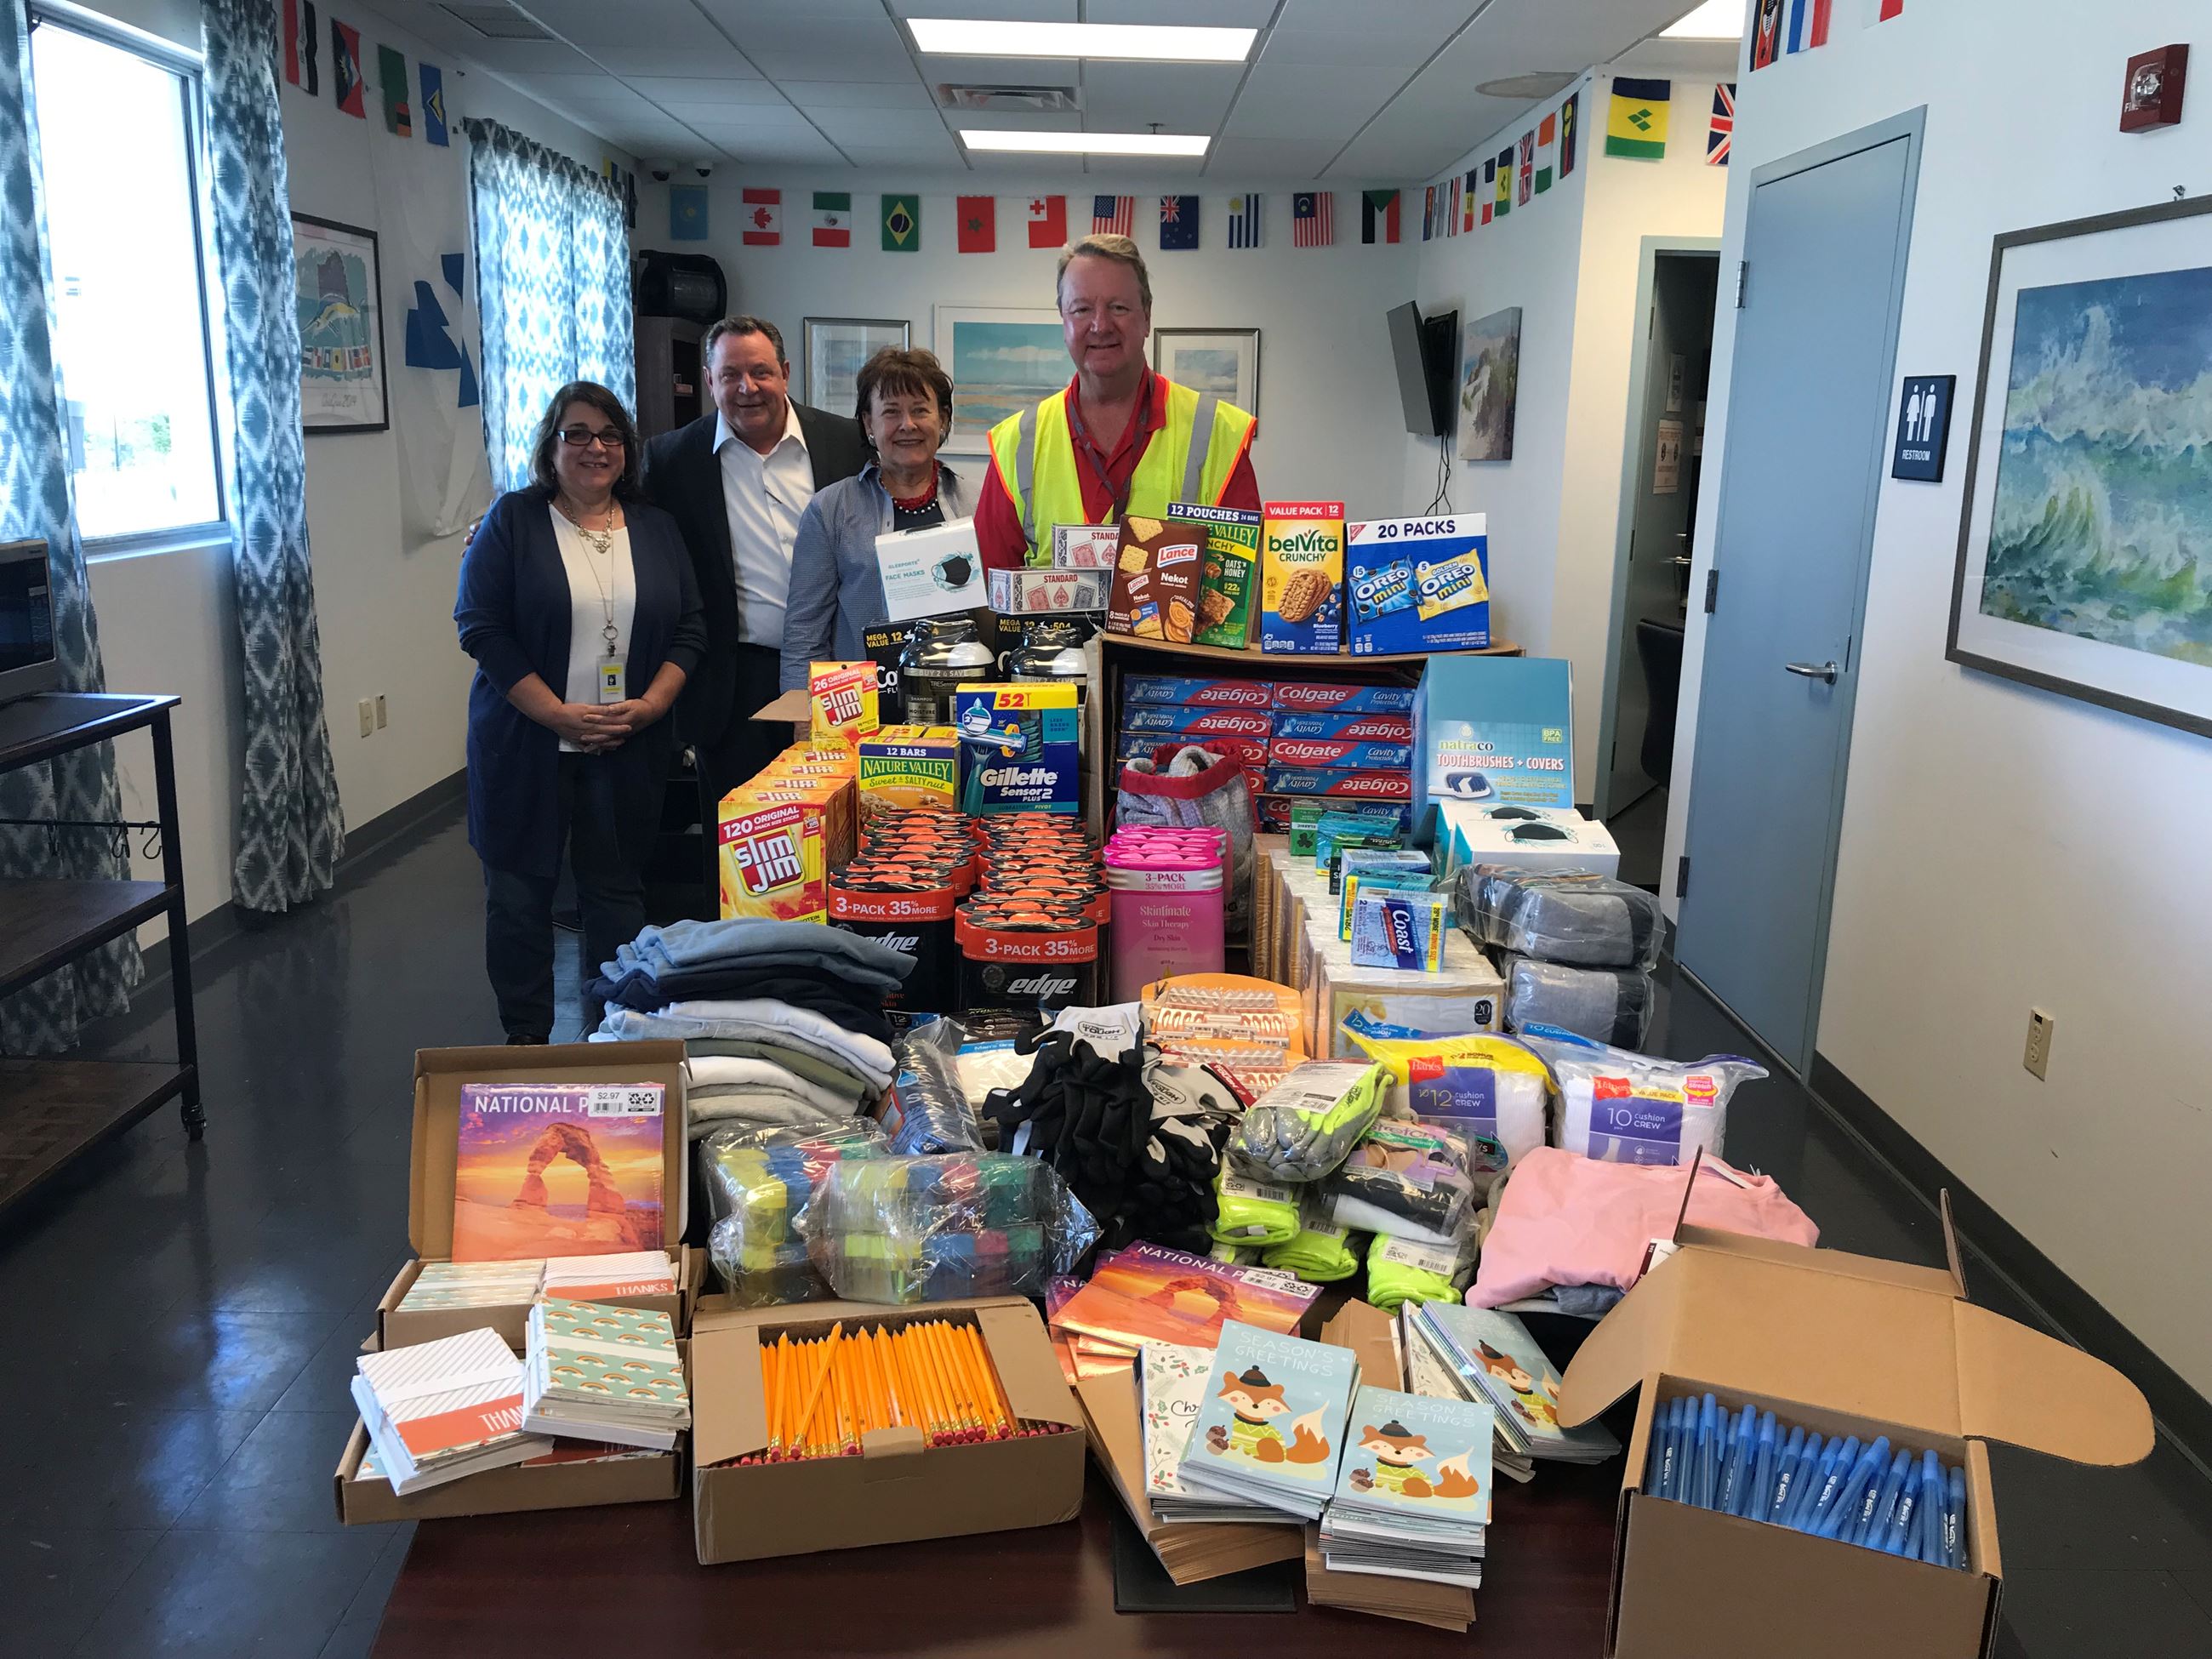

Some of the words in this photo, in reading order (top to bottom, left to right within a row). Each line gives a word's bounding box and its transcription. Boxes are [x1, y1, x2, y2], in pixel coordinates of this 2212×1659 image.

[1902, 449, 1930, 461] RESTROOM
[1171, 505, 1183, 516] 12
[1186, 507, 1240, 522] POUCHES
[1269, 507, 1297, 516] VALUE
[1299, 506, 1323, 516] PACK
[1328, 505, 1339, 514] 12
[1092, 532, 1119, 540] STANDA
[1214, 526, 1256, 547] VALLEY
[1377, 524, 1398, 539] 20
[1404, 520, 1456, 537] PACKS
[1206, 539, 1235, 550] NCHY
[1268, 529, 1338, 552] belVita
[1160, 548, 1195, 562] Lance
[1279, 553, 1326, 562] CRUNCHY
[1224, 559, 1241, 569] OATS
[1432, 562, 1458, 575] GOLDEN
[903, 569, 925, 578] MASKS
[1043, 574, 1078, 583] STANDARD
[1161, 573, 1189, 584] Nekot
[1224, 568, 1246, 579] HONEY
[1420, 564, 1475, 596] OREO
[1128, 576, 1149, 590] Lance
[1356, 569, 1410, 601] OREO
[1436, 576, 1472, 601] mini
[1372, 579, 1407, 605] mini
[866, 633, 887, 641] MEGA
[891, 631, 903, 641] 12
[866, 640, 890, 648] VALUE
[813, 679, 828, 692] 26
[828, 669, 860, 683] ORIGINAL
[999, 693, 1024, 708] 52
[1146, 689, 1174, 699] Cavity
[1200, 689, 1268, 705] Colgate
[1279, 687, 1347, 703] Colgate
[1372, 691, 1401, 700] Cavity
[1145, 718, 1173, 728] Cavity
[1200, 717, 1267, 733] Colgate
[1294, 724, 1322, 733] Cavity
[1348, 723, 1411, 739] Colgate
[887, 747, 898, 755] 12
[900, 748, 926, 756] BARS
[1275, 743, 1342, 759] Colgate
[1367, 747, 1396, 756] Cavity
[1440, 740, 1493, 751] natraco
[1436, 754, 1514, 768] TOOTHBRUSHES
[1526, 757, 1564, 770] COVERS
[864, 760, 908, 778] NATURE
[909, 761, 949, 780] VALLEY
[980, 767, 1058, 786] Gillette
[869, 776, 897, 788] Sweet
[904, 776, 926, 785] SALTY
[926, 780, 945, 790] nut
[1289, 780, 1316, 789] Cavity
[1343, 778, 1409, 794] Colgate
[1362, 806, 1389, 815] Cavity
[723, 819, 753, 838] 120
[754, 806, 800, 824] ORIGINAL
[783, 814, 800, 823] STICKS
[1145, 873, 1186, 882] 3-PACK
[836, 898, 886, 915] 3-PACK
[912, 906, 938, 915] MORE
[1140, 905, 1191, 916] Skintimate
[1160, 920, 1189, 929] Therapy
[1392, 909, 1413, 954] Coast
[985, 938, 1040, 956] 3-PACK
[1069, 944, 1095, 955] MORE
[1007, 973, 1077, 1001] edge
[1475, 1004, 1491, 1017] 20
[1083, 1025, 1120, 1035] TOUGH
[1412, 1061, 1441, 1071] Hanes
[1215, 1064, 1238, 1089] TOUGH
[597, 1092, 620, 1100] $2.97
[1430, 1089, 1452, 1106] 12
[475, 1096, 572, 1114] NATIONAL
[1607, 1108, 1632, 1126] 10
[1634, 1113, 1665, 1123] cushion
[1633, 1121, 1661, 1130] CREW
[1137, 1245, 1226, 1274] NATIONAL
[616, 1283, 668, 1296] THANKS
[1240, 1331, 1334, 1363] SEASON'S
[1234, 1345, 1334, 1377] GREETINGS
[1375, 1394, 1474, 1417] SEASON'S
[479, 1405, 524, 1433] THAN
[1372, 1405, 1475, 1428] GREETINGS
